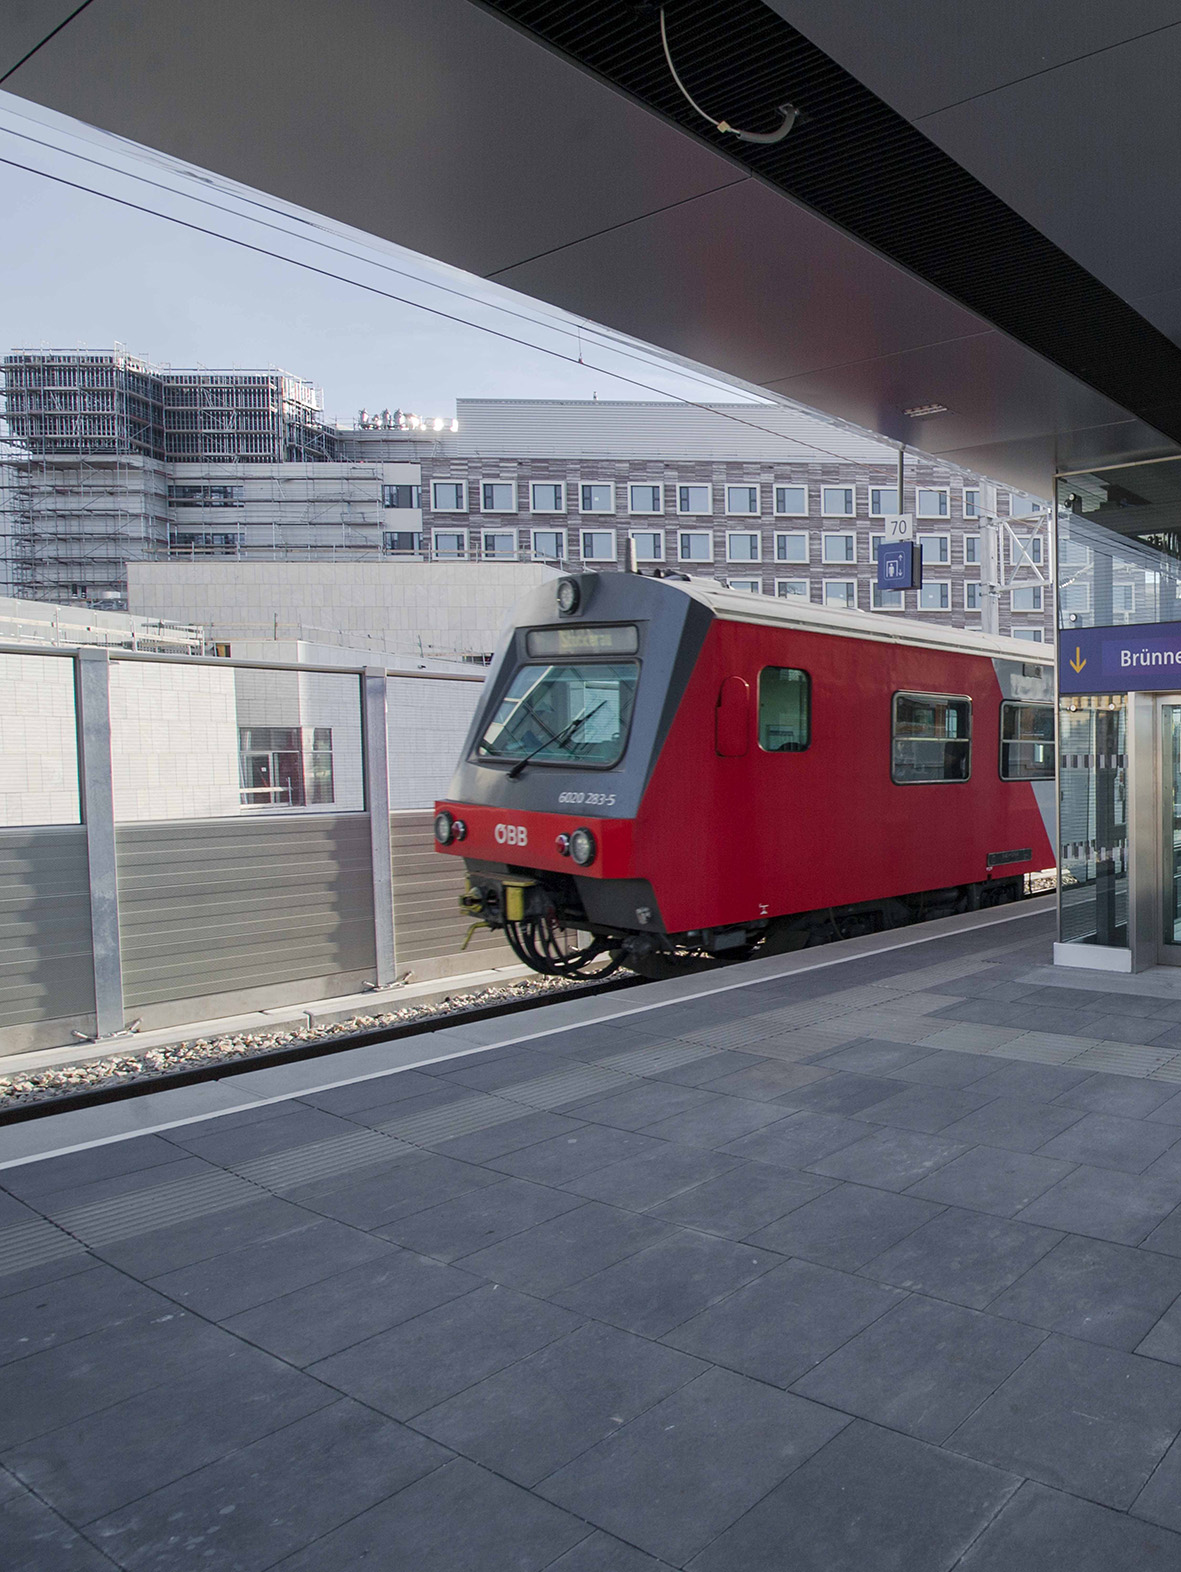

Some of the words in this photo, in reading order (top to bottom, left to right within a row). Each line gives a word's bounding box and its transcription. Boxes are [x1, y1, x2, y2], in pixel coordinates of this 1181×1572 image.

[890, 519, 907, 536] 70
[558, 791, 585, 804] 6020
[585, 793, 617, 806] 283-5
[494, 823, 529, 847] ÖBB
